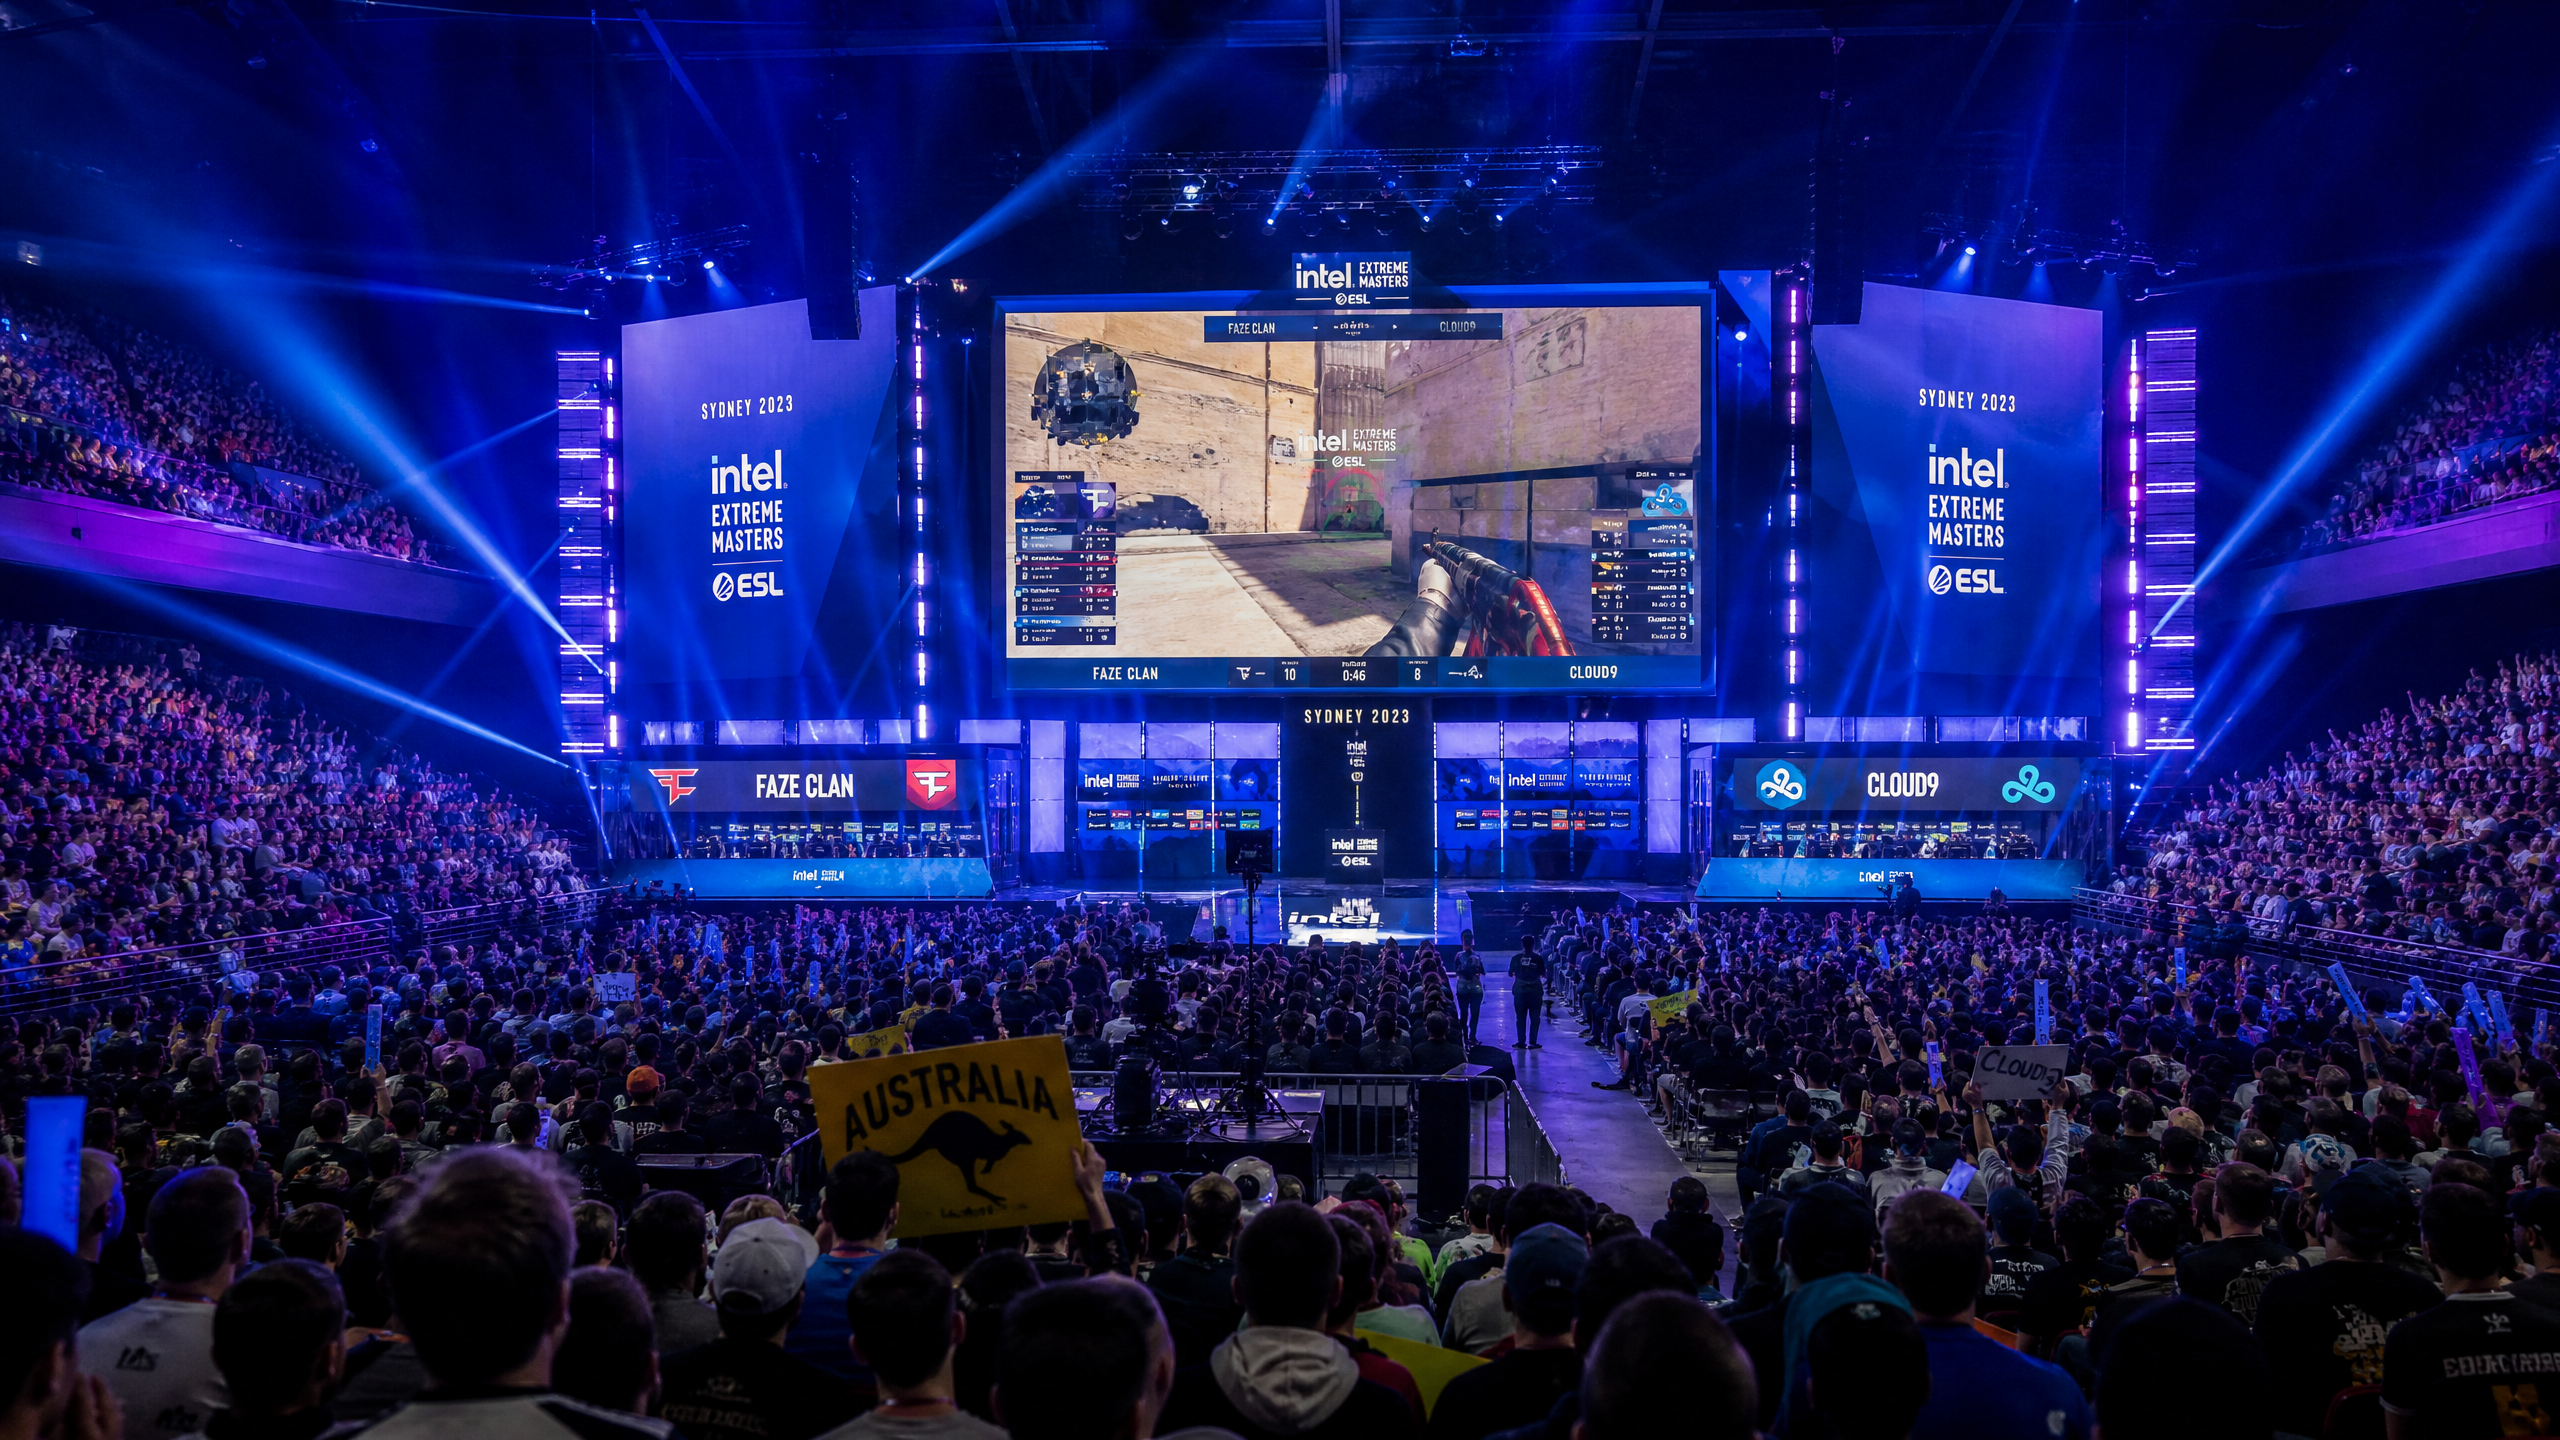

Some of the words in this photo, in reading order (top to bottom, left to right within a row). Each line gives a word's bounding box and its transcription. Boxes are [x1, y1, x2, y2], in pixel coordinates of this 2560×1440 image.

[1296, 262, 1352, 289] intel
[1360, 261, 1409, 274] EXTREME
[1360, 275, 1409, 288] MASTERS
[1348, 293, 1371, 305] ESL
[1228, 322, 1250, 334] FAZE
[1252, 322, 1275, 334] CLAN
[702, 398, 752, 420] SYDNEY
[759, 394, 794, 415] 2023
[1919, 388, 1974, 409] SYDNEY
[1981, 393, 2016, 413] 2023
[1298, 429, 1347, 452] intel
[1353, 428, 1397, 440] EXTREME
[1353, 440, 1397, 451] MASTERS
[711, 449, 783, 494] intel
[1344, 456, 1366, 467] ESL
[1928, 443, 2004, 489] intel
[711, 500, 783, 527] EXTREME
[1928, 494, 2005, 521] EXTREME
[711, 527, 784, 553] MASTERS
[1928, 521, 2005, 548] MASTERS
[737, 571, 784, 597] ESL
[1955, 568, 2004, 594] ESL
[1093, 666, 1124, 681] FAZE
[1126, 666, 1159, 681] CLAN
[1284, 668, 1296, 681] 10
[1342, 669, 1366, 681] 0:46
[1414, 668, 1421, 681] 8
[1569, 665, 1618, 680] CLOUD9
[1304, 709, 1362, 724] SYDNEY
[1371, 709, 1410, 724] 2023
[756, 774, 800, 799] FAZE
[805, 773, 854, 798] CLAN
[1084, 773, 1113, 788] intel
[1867, 771, 1940, 797] CLOUD9
[845, 1061, 1059, 1151] AUSTRALIA
